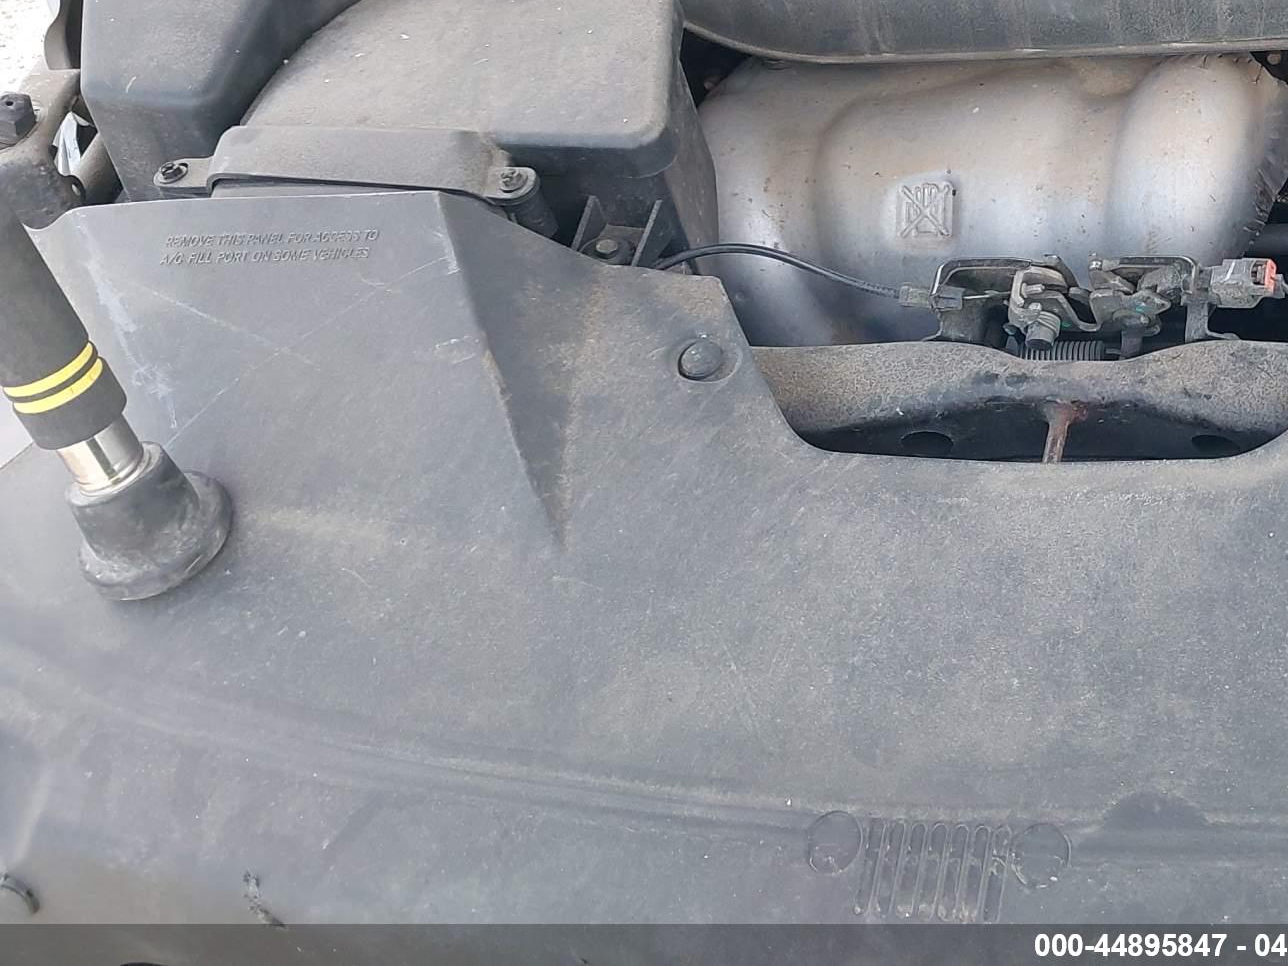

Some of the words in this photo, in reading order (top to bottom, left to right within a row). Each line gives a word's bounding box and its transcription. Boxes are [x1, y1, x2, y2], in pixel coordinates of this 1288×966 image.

[166, 233, 214, 248] REMOVE
[217, 232, 244, 247] THIS
[247, 231, 284, 246] PANEL
[287, 231, 311, 244] FOR
[363, 229, 379, 242] TO
[188, 250, 212, 265] FILL
[216, 249, 248, 264] PORT
[252, 249, 271, 263] ON
[273, 248, 310, 262] SOME
[312, 246, 371, 261] VEHICLES
